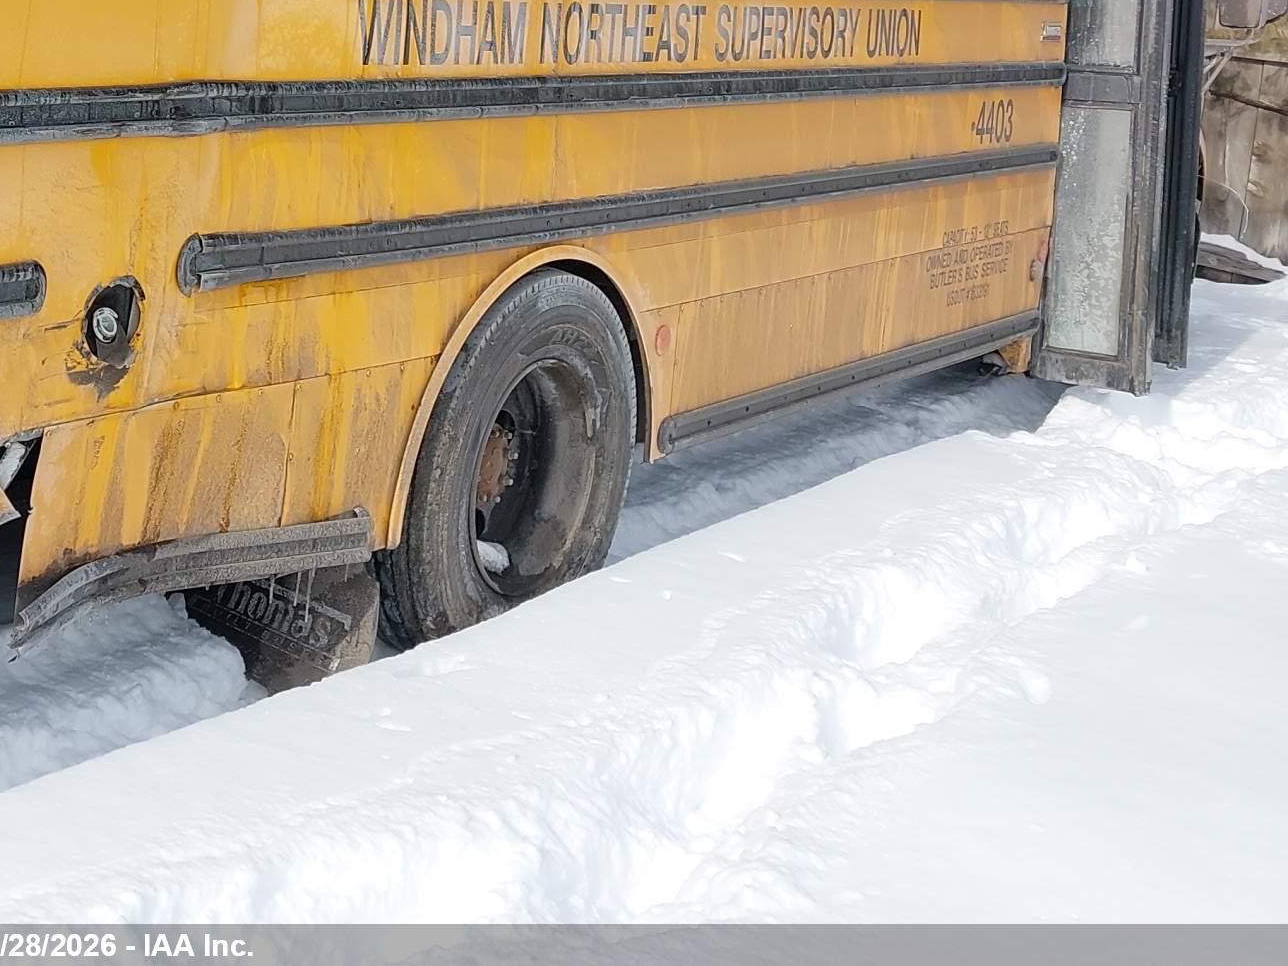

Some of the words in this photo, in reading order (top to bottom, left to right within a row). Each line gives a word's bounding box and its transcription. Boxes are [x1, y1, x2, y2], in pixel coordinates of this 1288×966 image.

[540, 1, 707, 64] NORTHEAST
[714, 5, 862, 62] SUPERVISORY
[865, 8, 922, 57] UNION
[926, 251, 952, 273] OWNED
[953, 246, 968, 265] AND
[969, 240, 1004, 263] OPERATED
[964, 263, 979, 282] BUS
[980, 257, 1009, 278] SERVICE
